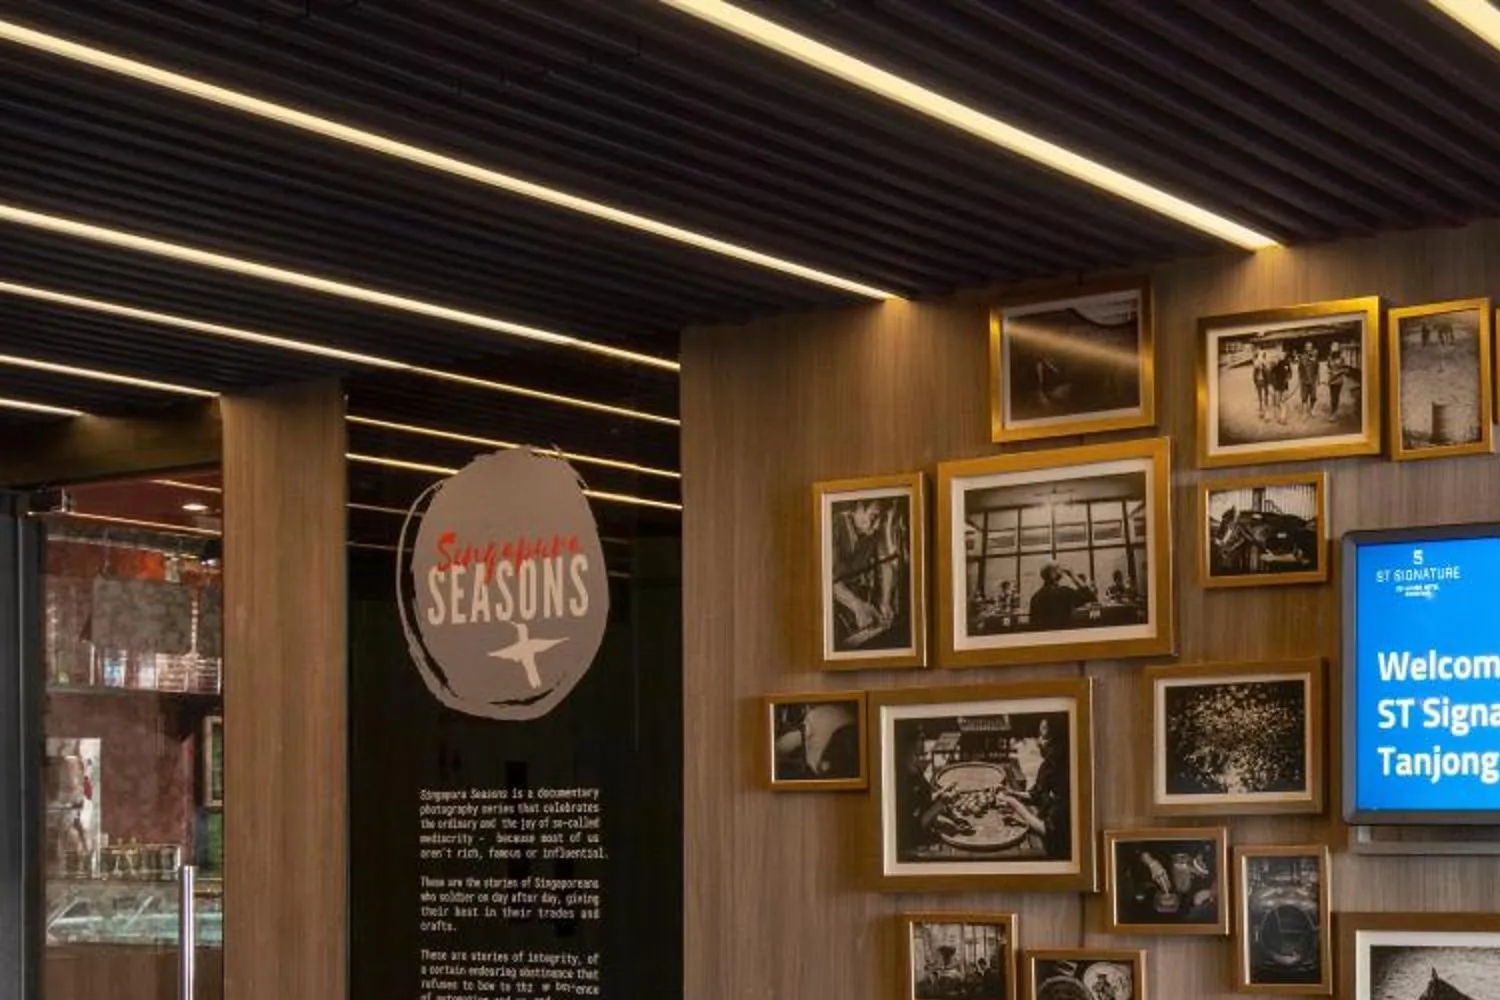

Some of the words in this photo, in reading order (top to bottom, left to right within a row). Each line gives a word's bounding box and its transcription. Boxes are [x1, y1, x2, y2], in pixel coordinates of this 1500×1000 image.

[1376, 570, 1390, 583] ST
[1394, 565, 1461, 582] SIGNATURE
[428, 554, 588, 625] SEASONS
[1378, 698, 1414, 729] ST
[1378, 745, 1500, 784] Tanjong
[512, 788, 523, 798] is
[569, 832, 581, 842] of
